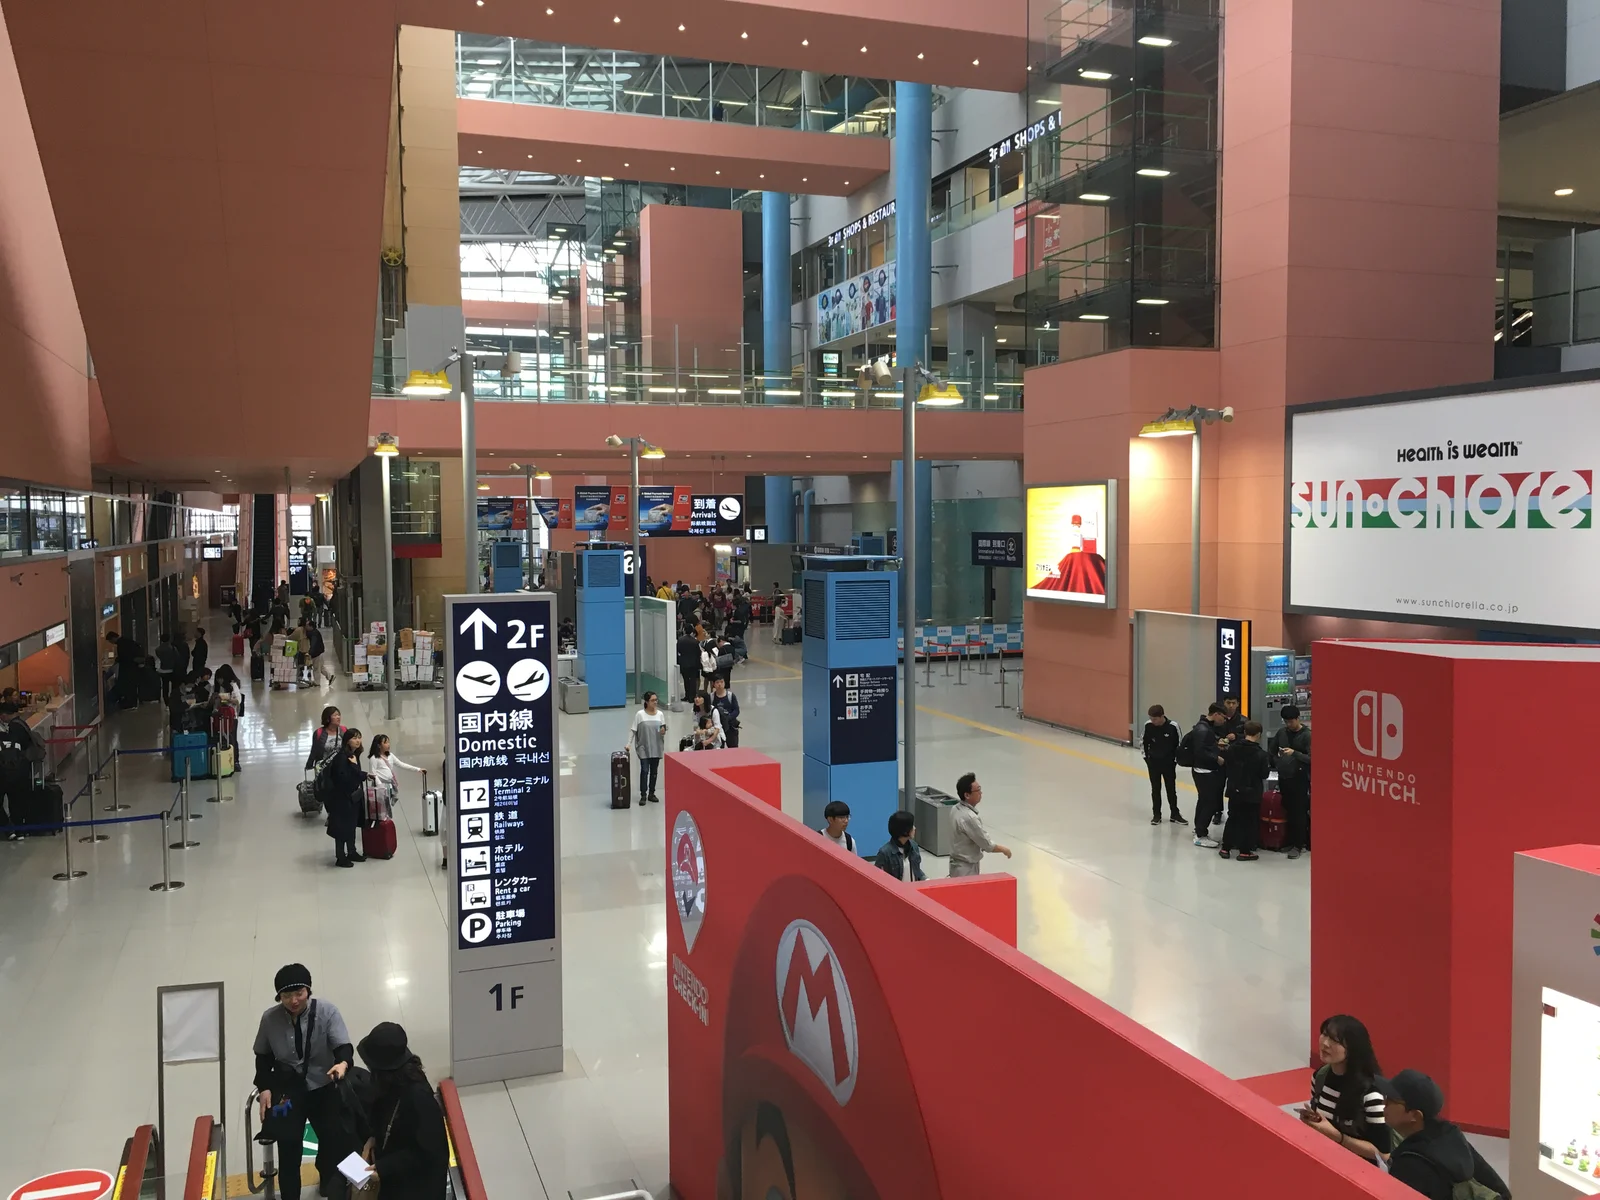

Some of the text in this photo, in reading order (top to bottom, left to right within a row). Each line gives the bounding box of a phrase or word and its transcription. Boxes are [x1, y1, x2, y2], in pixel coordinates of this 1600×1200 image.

[1014, 120, 1045, 150] SHOPS
[1048, 115, 1056, 131] &
[843, 220, 862, 240] SHOPS
[862, 217, 867, 230] &
[1447, 440, 1459, 460] is
[694, 498, 716, 510] 到着
[1395, 596, 1519, 614] www.sunchlorella.co.jp
[506, 619, 544, 650] 2F
[1222, 652, 1232, 693] Vending
[458, 708, 534, 734] 国内線
[458, 734, 537, 753] Domestic
[459, 754, 508, 769] 国内航线
[514, 752, 550, 765] 국내선
[1342, 759, 1416, 784] NINTENDO
[494, 776, 549, 788] 第2ターミナル
[494, 787, 524, 795] Terminal
[463, 787, 487, 803] T2
[494, 843, 524, 854] ホテル
[494, 876, 537, 887] レンタカー
[496, 909, 525, 920] 駐車場
[496, 920, 522, 928] Parking
[672, 952, 709, 1005] NINTENDO
[488, 982, 524, 1011] 1F
[672, 973, 710, 1027] CHECK-IN
